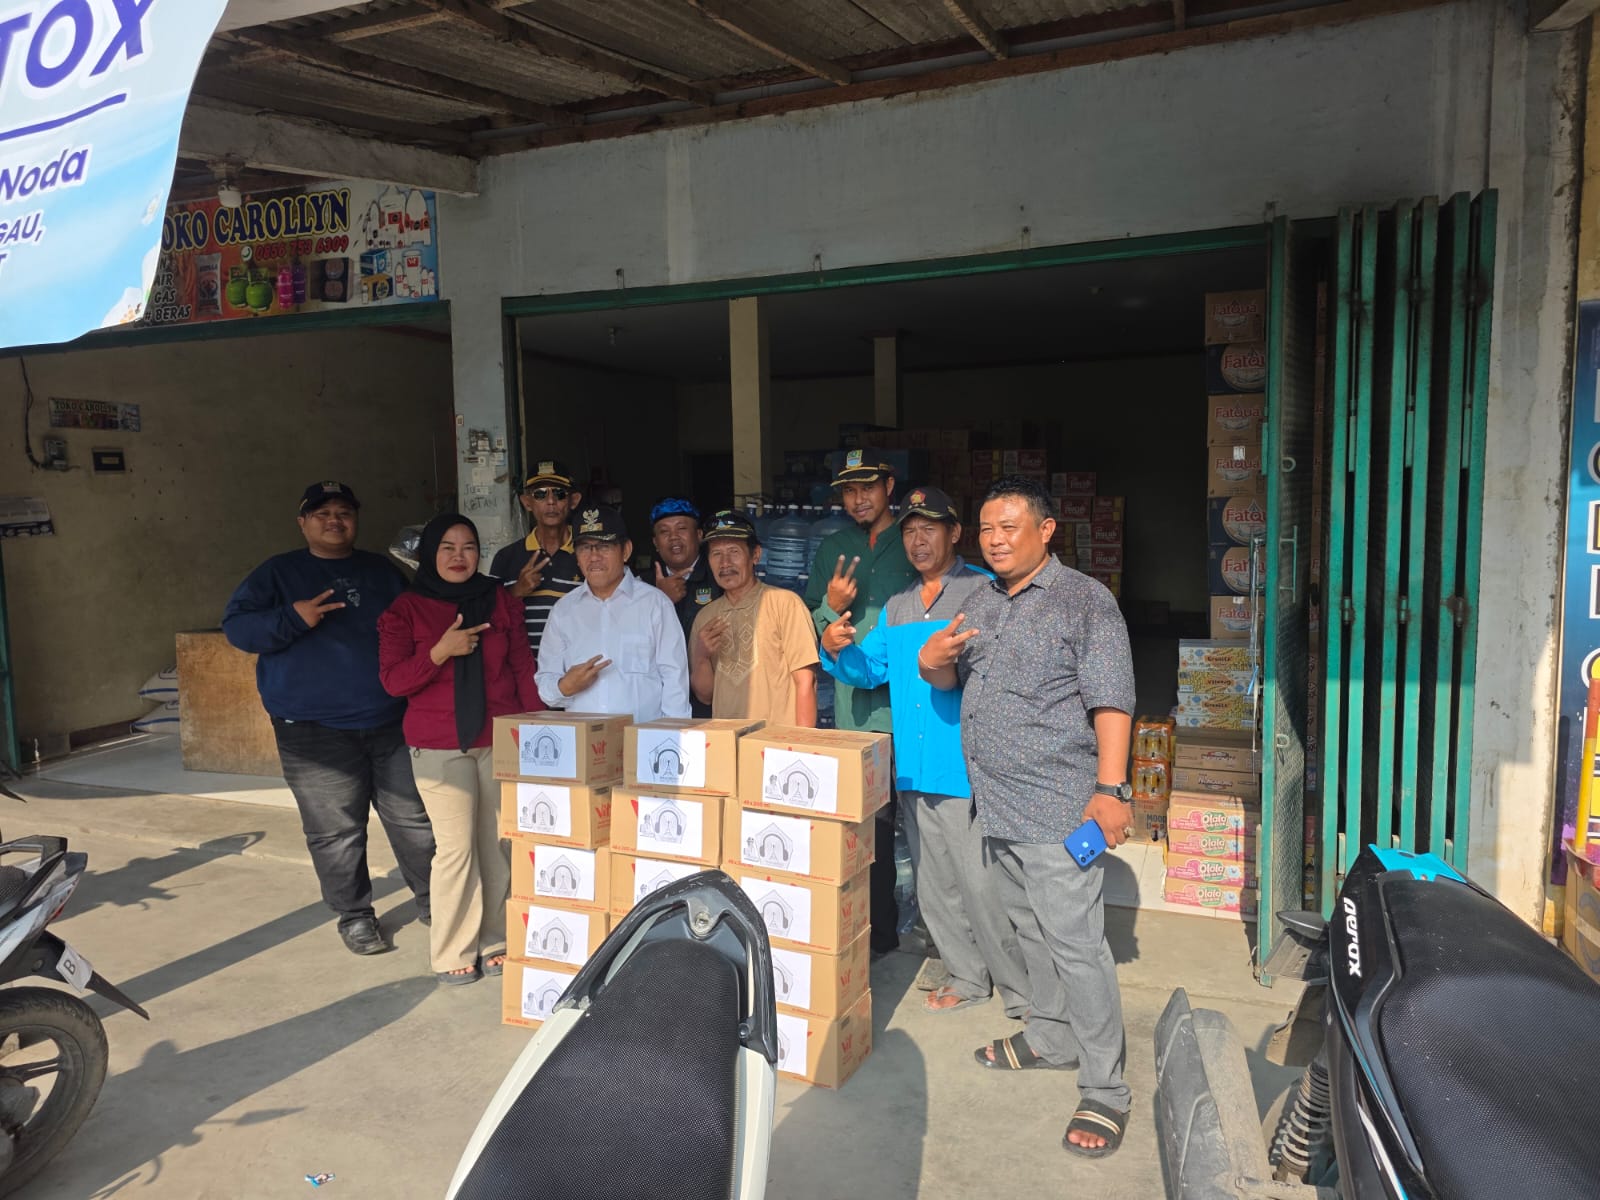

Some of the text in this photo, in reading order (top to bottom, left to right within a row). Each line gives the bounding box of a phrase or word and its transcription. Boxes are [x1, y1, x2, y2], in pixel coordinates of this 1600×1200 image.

[162, 190, 349, 251] OKO CAROLLYN
[155, 290, 175, 304] GAS
[155, 305, 191, 321] BERAS
[1343, 896, 1362, 978] aerox
[63, 959, 76, 975] B
